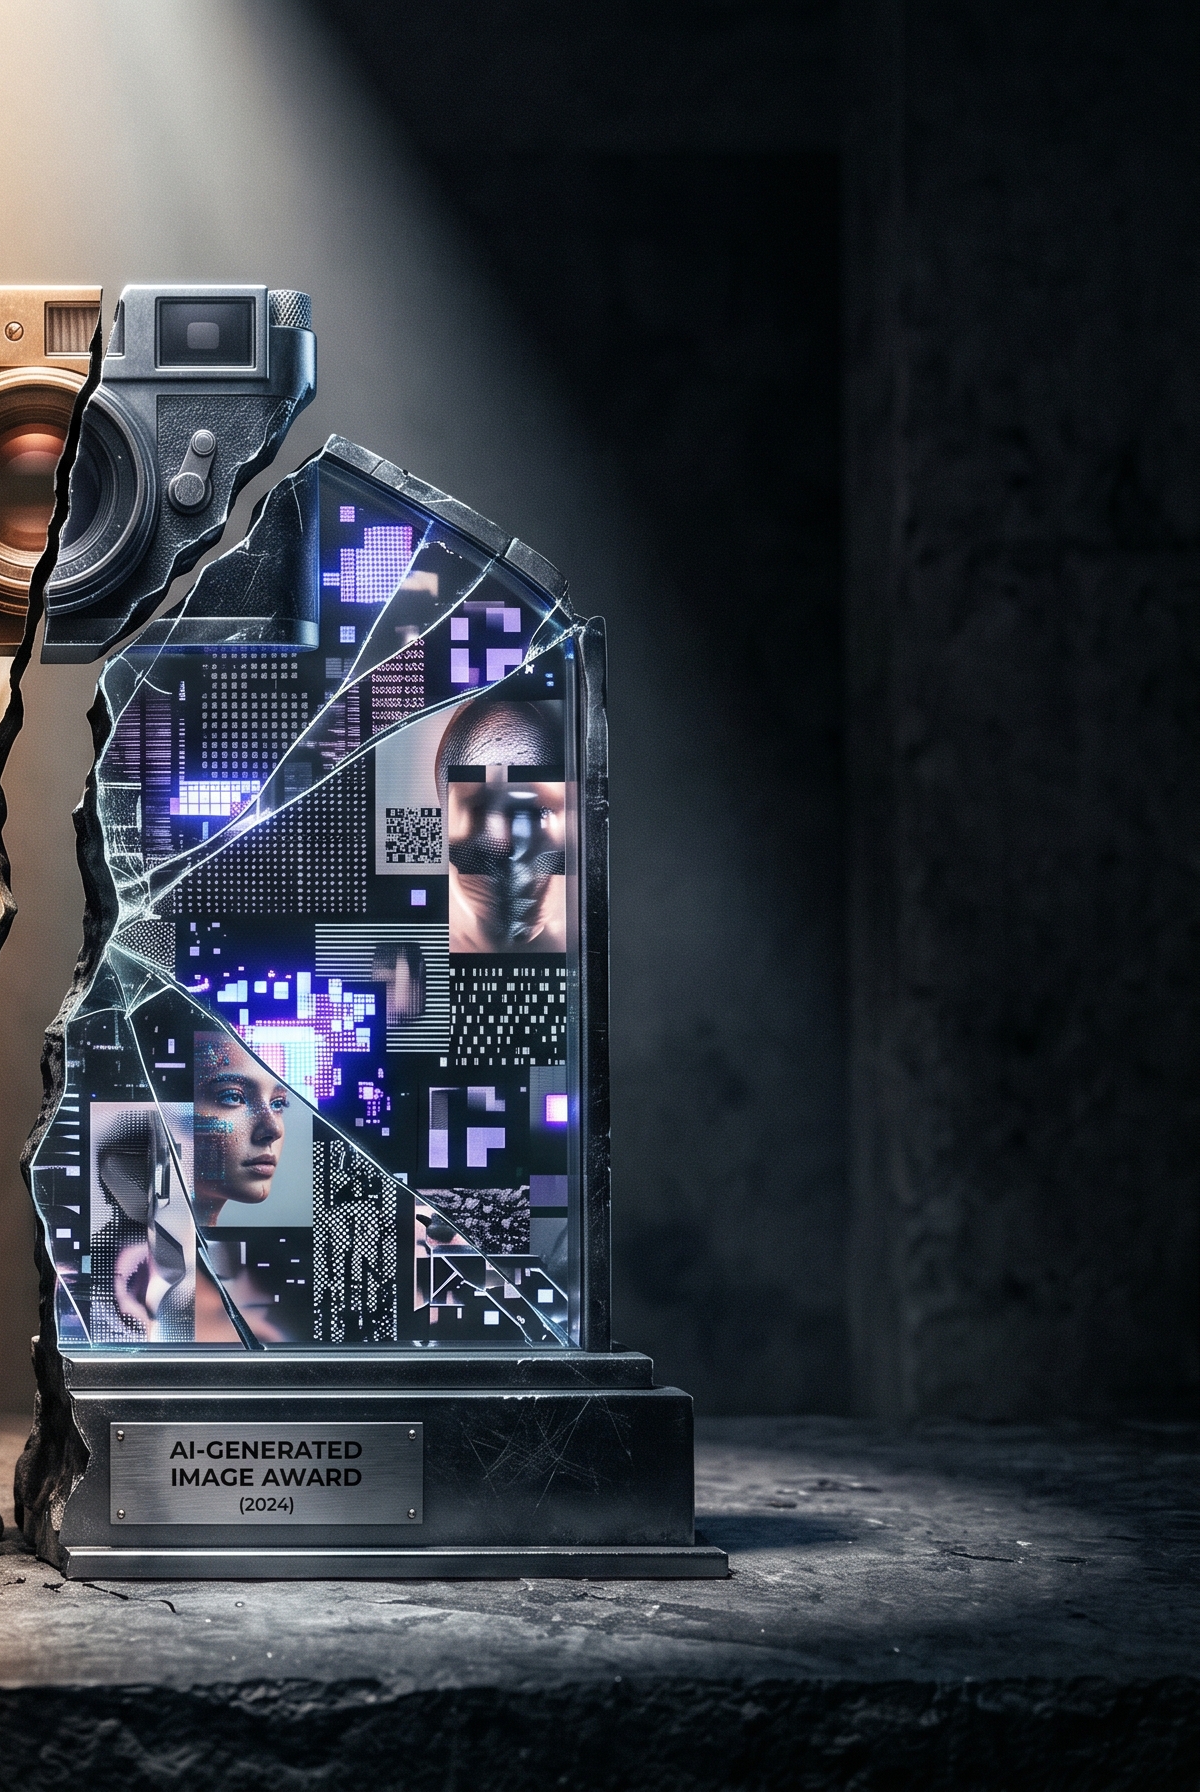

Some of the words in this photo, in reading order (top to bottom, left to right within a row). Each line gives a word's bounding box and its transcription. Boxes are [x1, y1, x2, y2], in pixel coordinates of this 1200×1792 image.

[169, 1440, 363, 1460] AI-GENERATED
[171, 1468, 254, 1487] IMAGE
[261, 1468, 362, 1487] AWARD
[239, 1497, 295, 1515] (2024)
